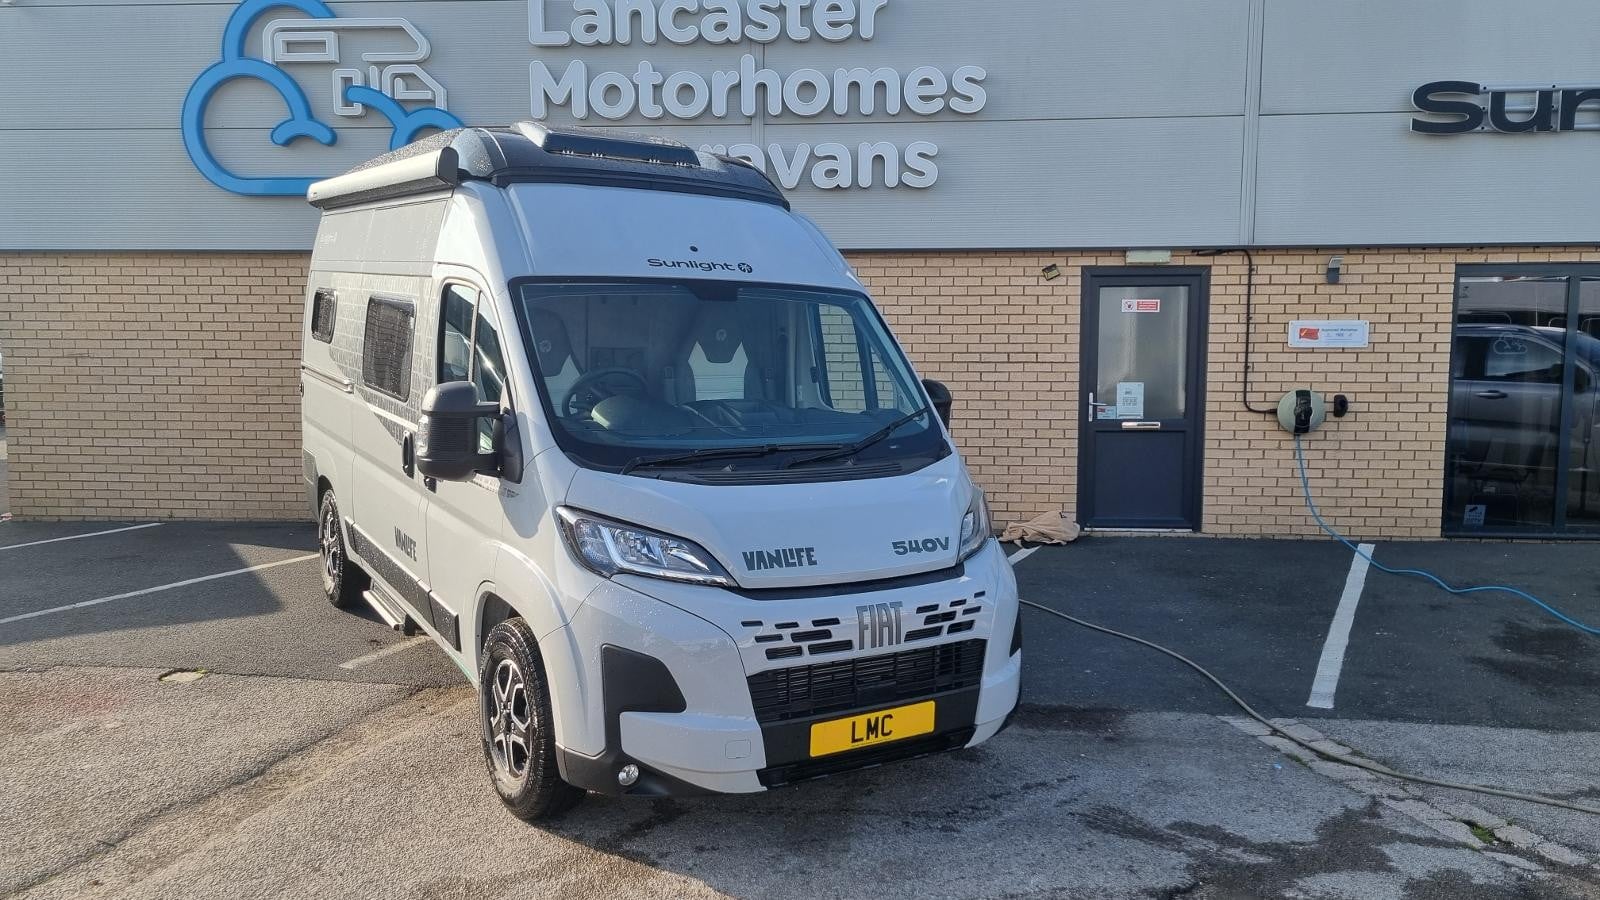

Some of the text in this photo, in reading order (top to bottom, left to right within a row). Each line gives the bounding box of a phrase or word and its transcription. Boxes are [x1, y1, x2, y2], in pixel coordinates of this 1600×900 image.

[528, 0, 888, 46] Lancaster
[529, 54, 988, 120] Motorhomes
[647, 258, 736, 272] Sunlight
[741, 547, 818, 571] VANLIFE
[891, 536, 950, 556] 540V
[855, 601, 903, 650] FIAT
[850, 713, 894, 744] LMC
